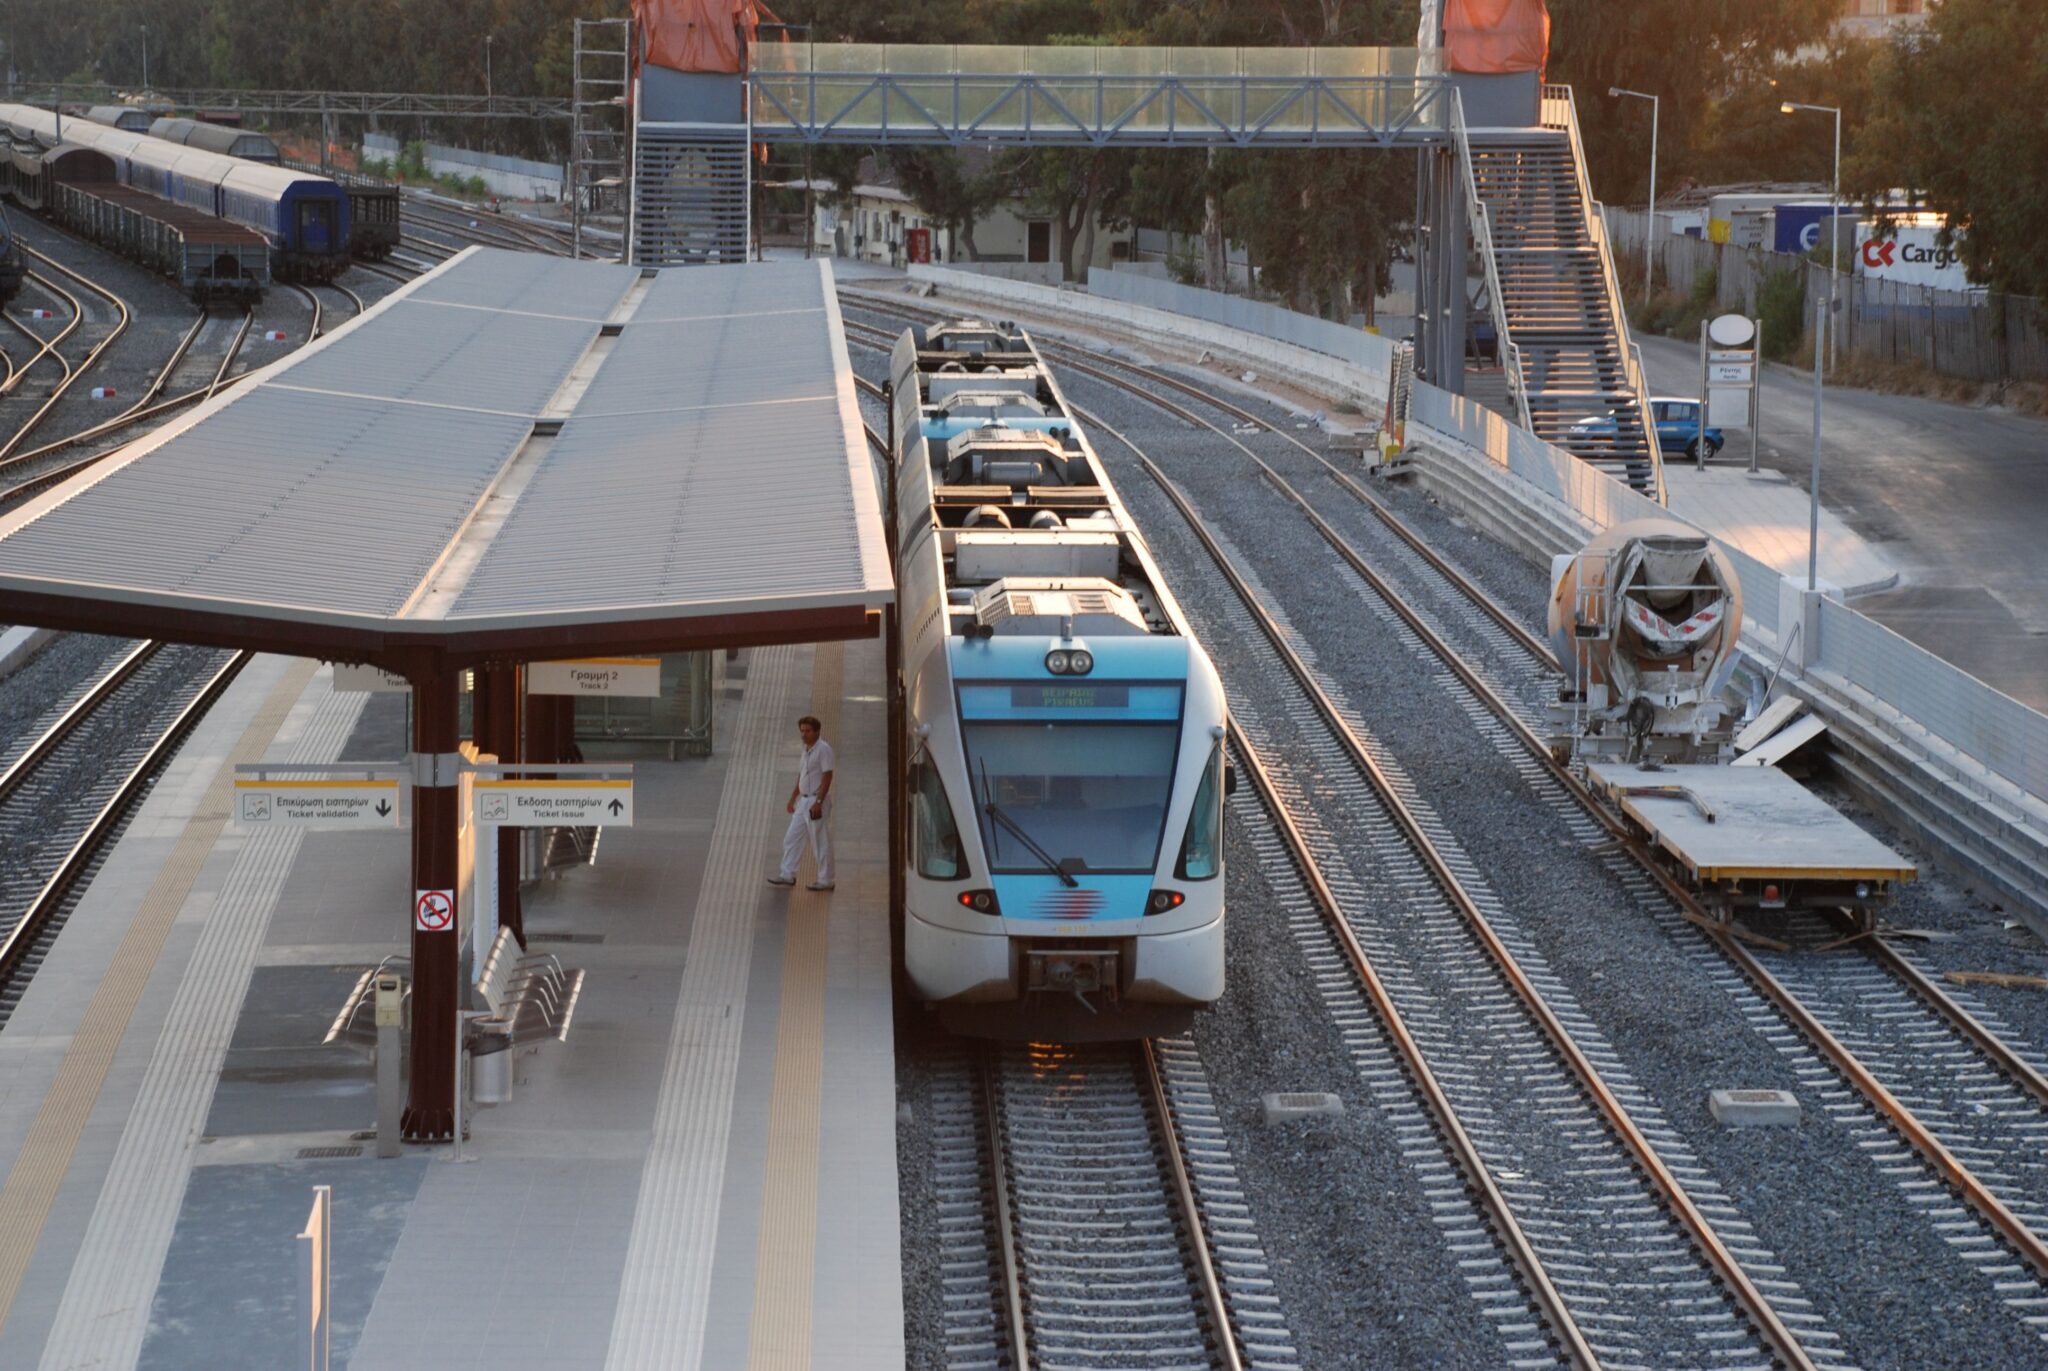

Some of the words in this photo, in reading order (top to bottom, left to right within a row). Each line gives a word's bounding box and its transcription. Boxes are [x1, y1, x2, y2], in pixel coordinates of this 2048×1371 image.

[1901, 243, 1960, 270] Cargo
[570, 669, 609, 682] Γραμμή
[611, 671, 618, 680] 2
[580, 682, 602, 690] Track
[603, 682, 610, 690] 2
[276, 796, 324, 808] Επικύρωση
[515, 796, 553, 808] Έκδοση
[287, 810, 314, 818] Ticket
[316, 809, 359, 818] validation
[533, 810, 560, 818] Ticket
[562, 810, 585, 818] issue
